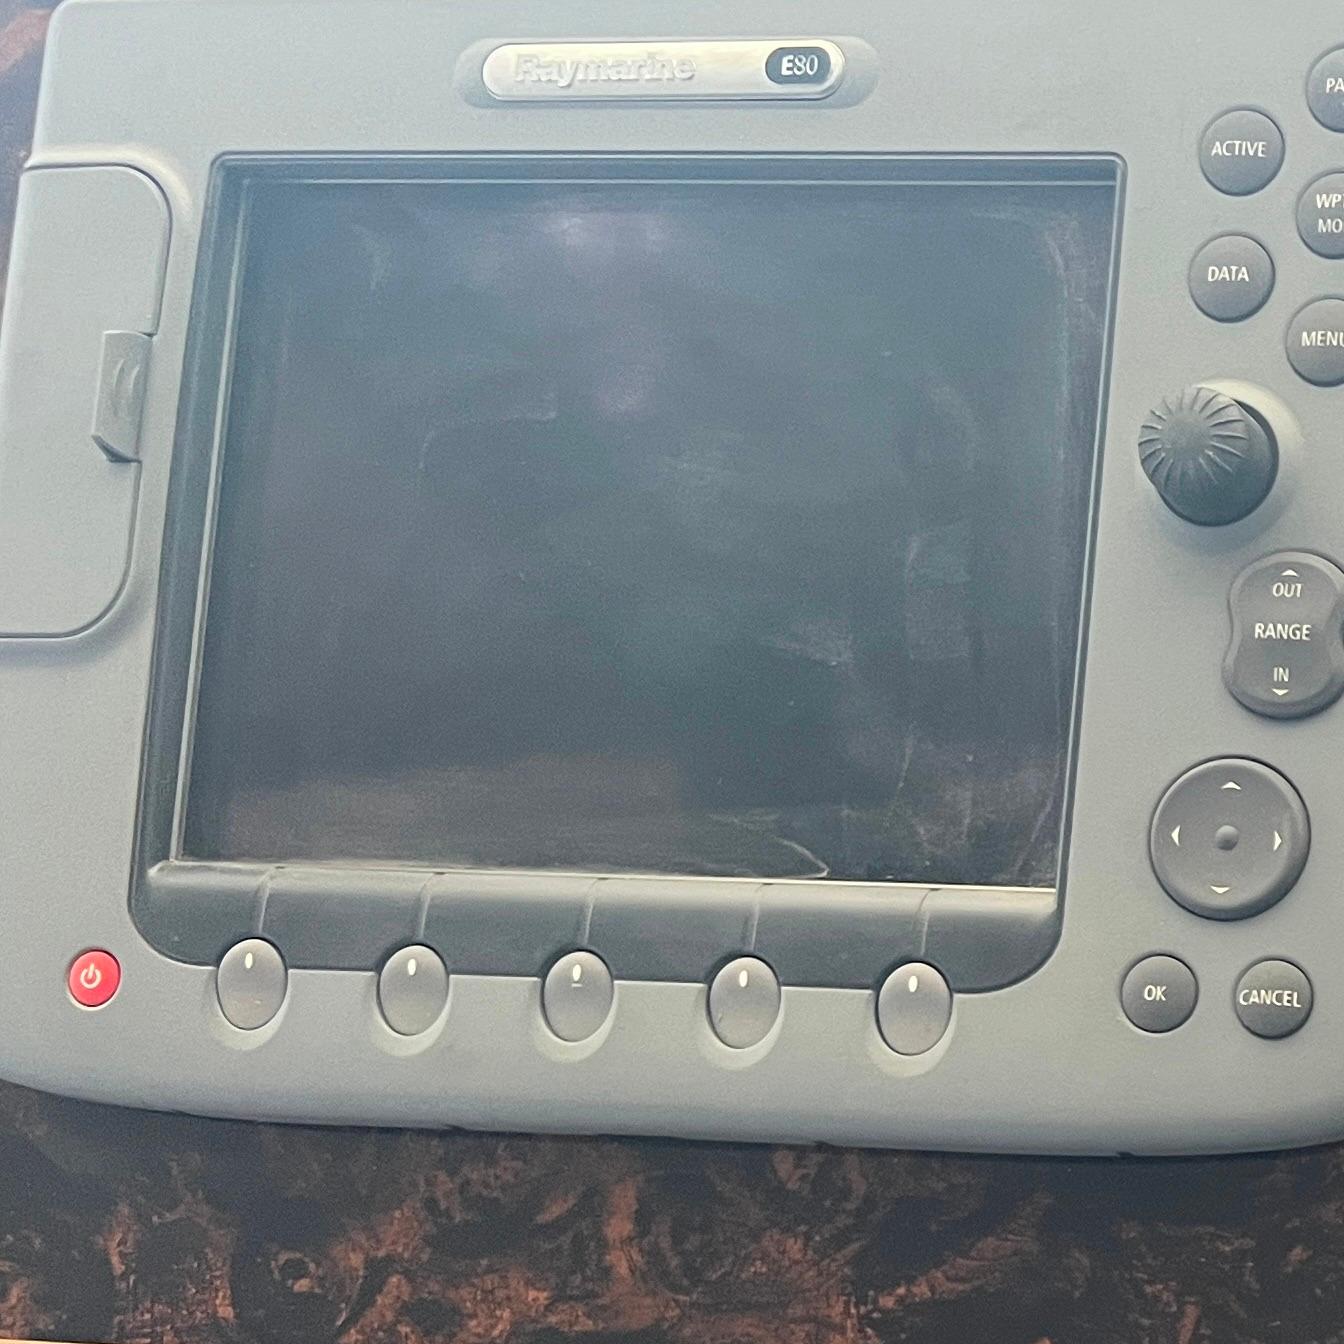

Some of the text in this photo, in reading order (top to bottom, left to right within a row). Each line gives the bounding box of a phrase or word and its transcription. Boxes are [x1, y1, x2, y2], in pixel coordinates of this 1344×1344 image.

[515, 52, 696, 87] Raymarine
[781, 54, 818, 76] E80
[1211, 141, 1266, 158] ACTIVE
[1208, 266, 1249, 282] DATA
[1272, 583, 1302, 598] OUT
[1254, 623, 1311, 641] RANGE
[1273, 667, 1289, 682] IN
[1144, 985, 1166, 1001] OK
[1239, 989, 1301, 1008] CANCEL
